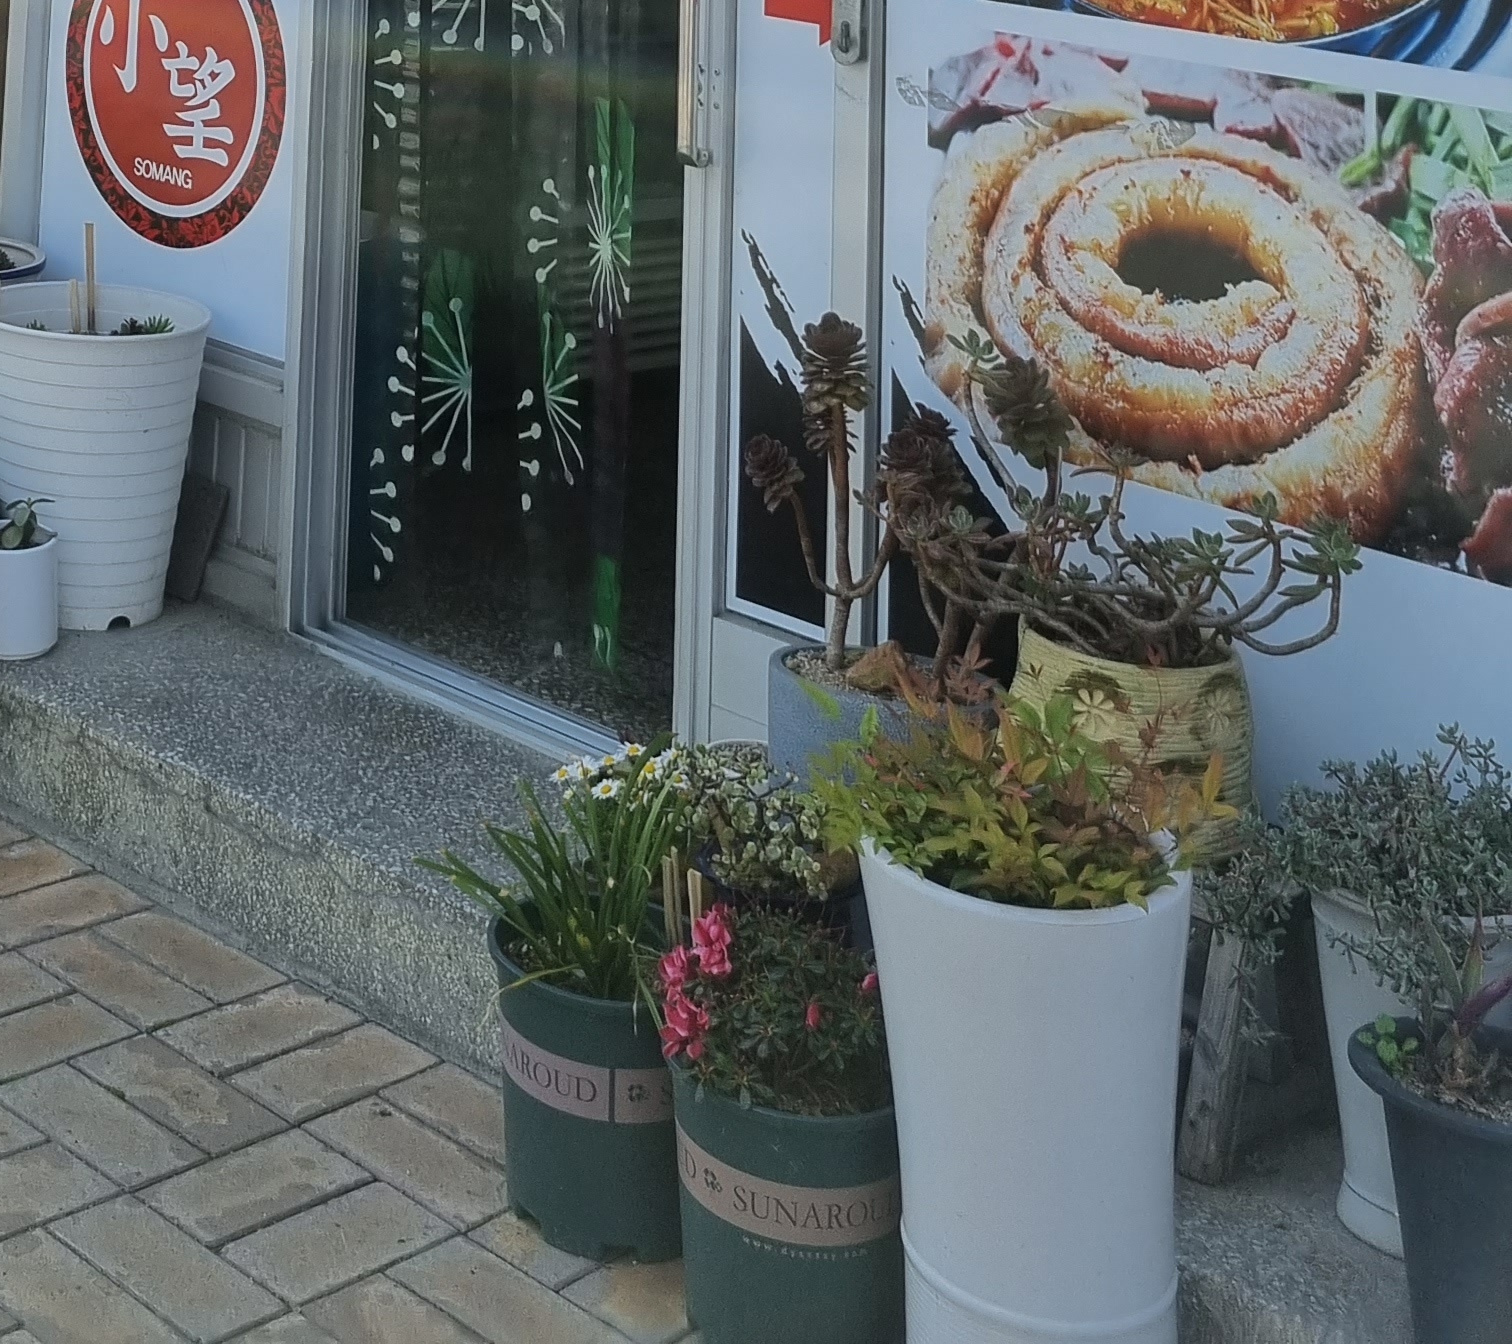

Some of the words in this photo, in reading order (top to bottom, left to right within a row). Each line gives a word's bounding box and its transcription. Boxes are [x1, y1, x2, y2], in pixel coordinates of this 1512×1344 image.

[133, 157, 193, 190] SOMANG
[504, 1042, 597, 1103] AROUD
[733, 1184, 890, 1230] SUNAROU
